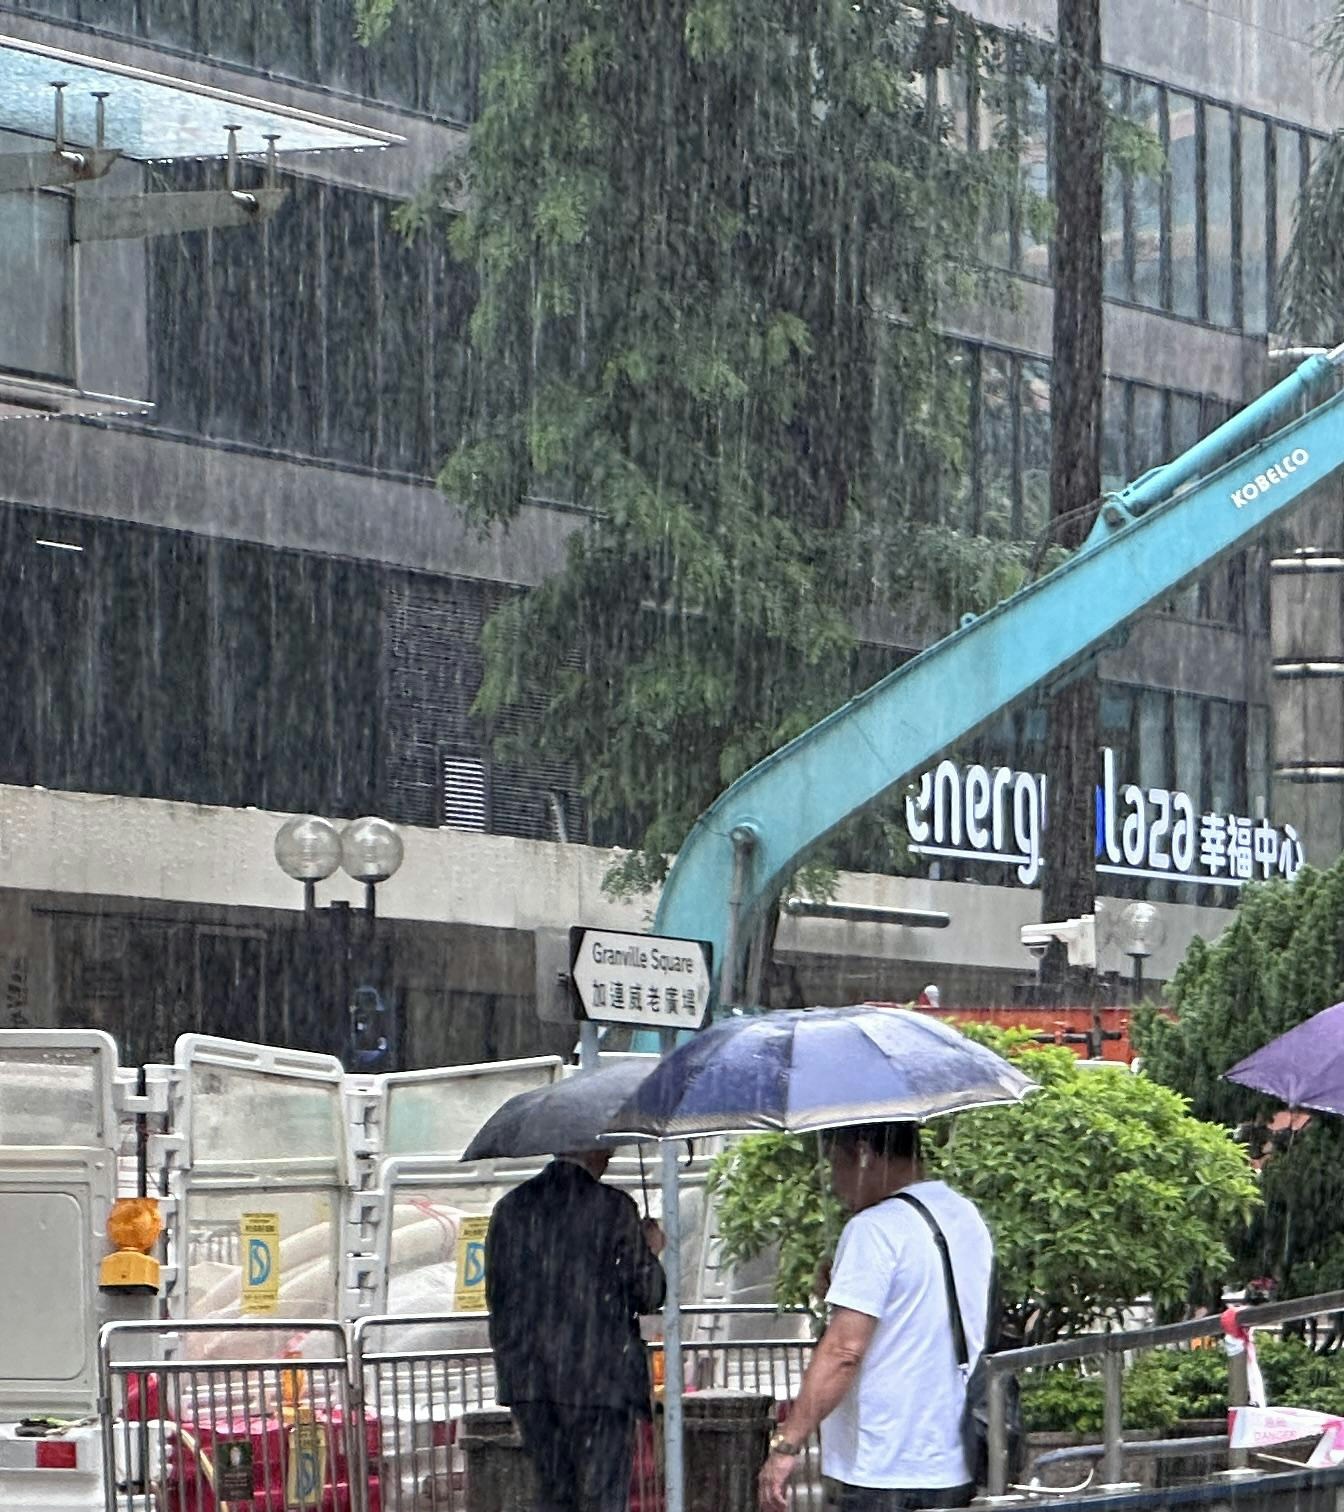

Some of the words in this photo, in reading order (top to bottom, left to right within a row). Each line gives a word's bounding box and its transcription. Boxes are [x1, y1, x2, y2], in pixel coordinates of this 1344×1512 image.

[1231, 448, 1309, 509] KOBELCO
[1095, 747, 1195, 872] laza
[1200, 812, 1305, 881] 幸福中心
[592, 941, 648, 969] Granville
[650, 948, 695, 975] Square
[592, 979, 697, 1017] 加連威老廣場
